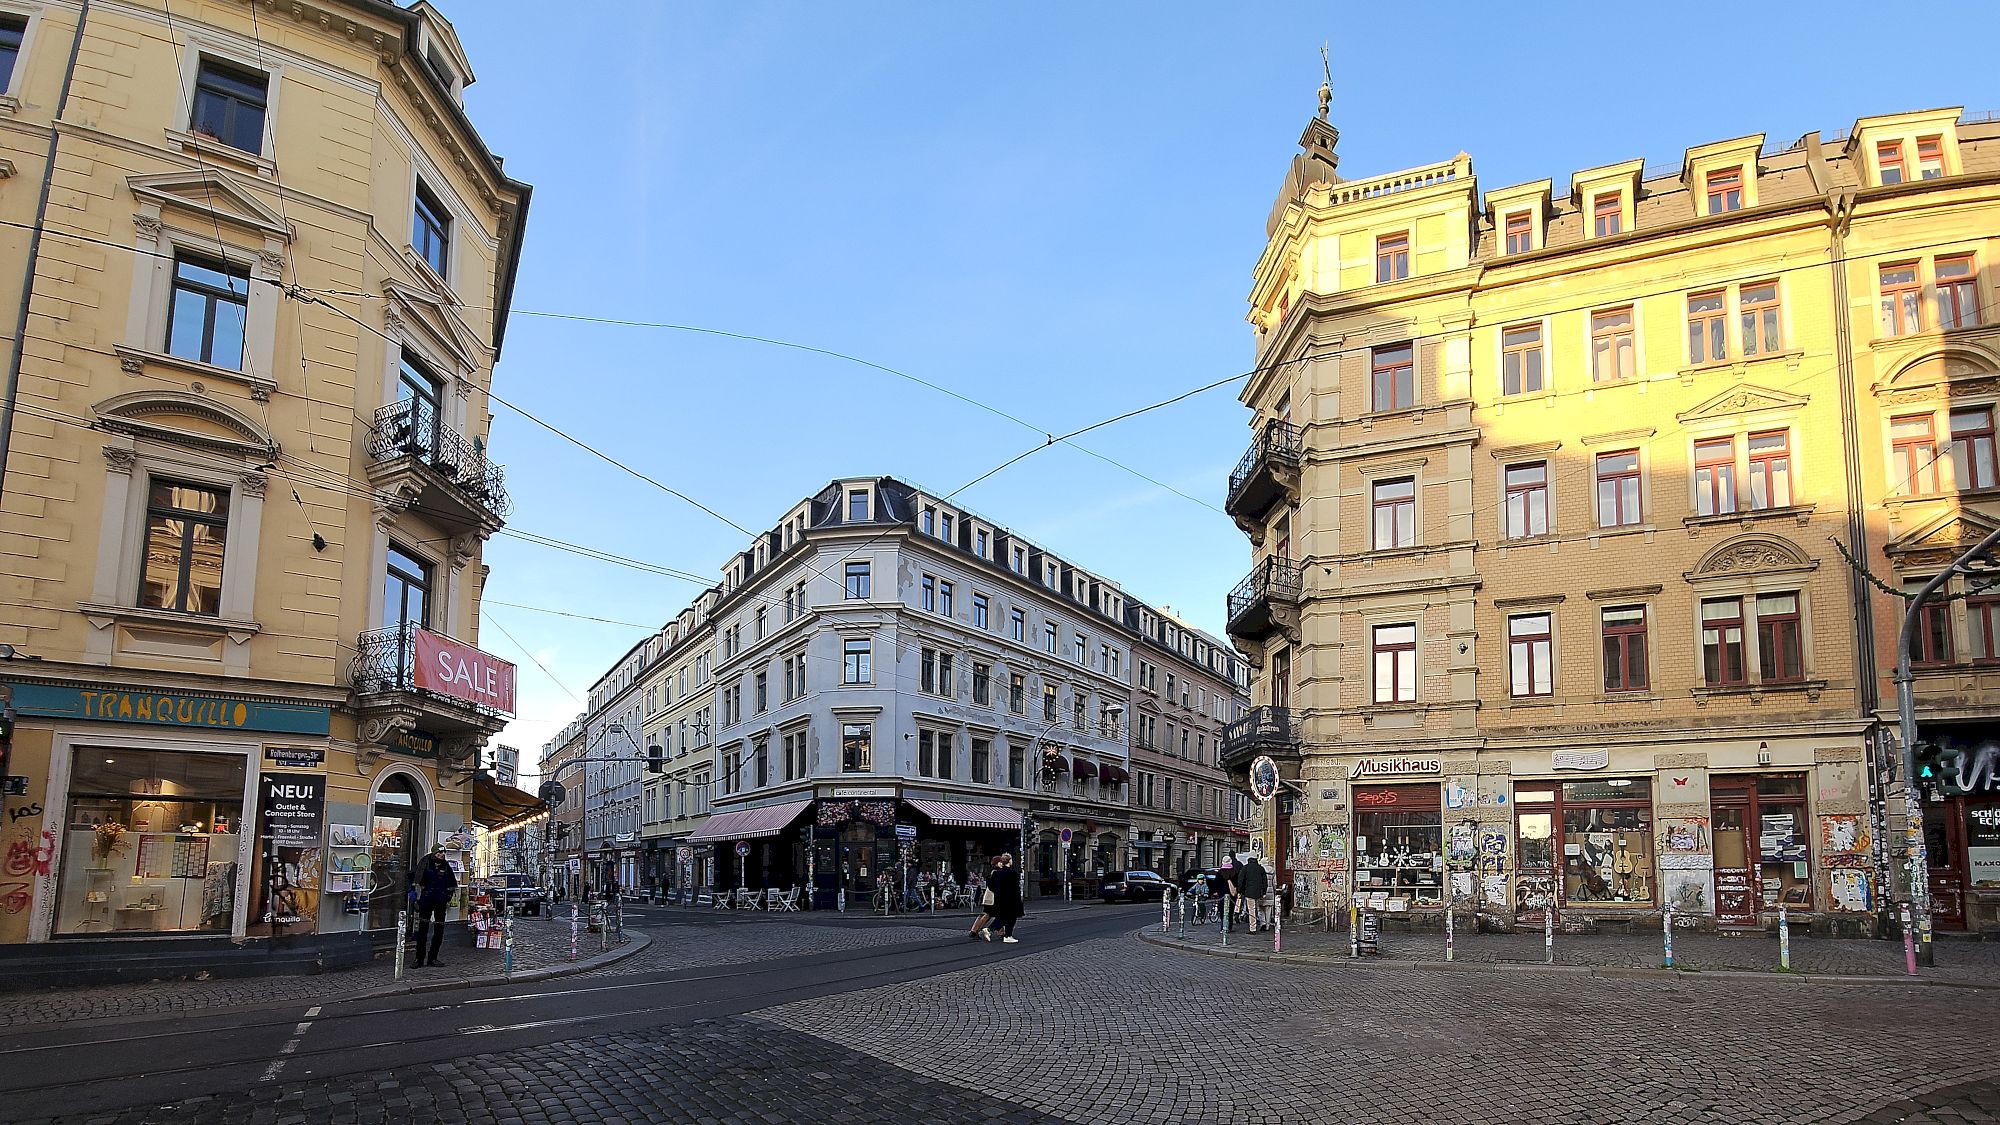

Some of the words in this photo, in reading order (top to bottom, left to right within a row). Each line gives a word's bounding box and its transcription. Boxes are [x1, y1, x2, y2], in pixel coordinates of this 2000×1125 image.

[438, 650, 498, 698] SALE
[80, 691, 248, 727] TRANQUILLO
[1352, 759, 1439, 776] Musikhaus
[270, 784, 313, 799] NEU!
[265, 809, 295, 818] Concept
[275, 803, 299, 811] Outlet
[376, 837, 401, 848] SALE
[263, 912, 301, 923] trnquillo
